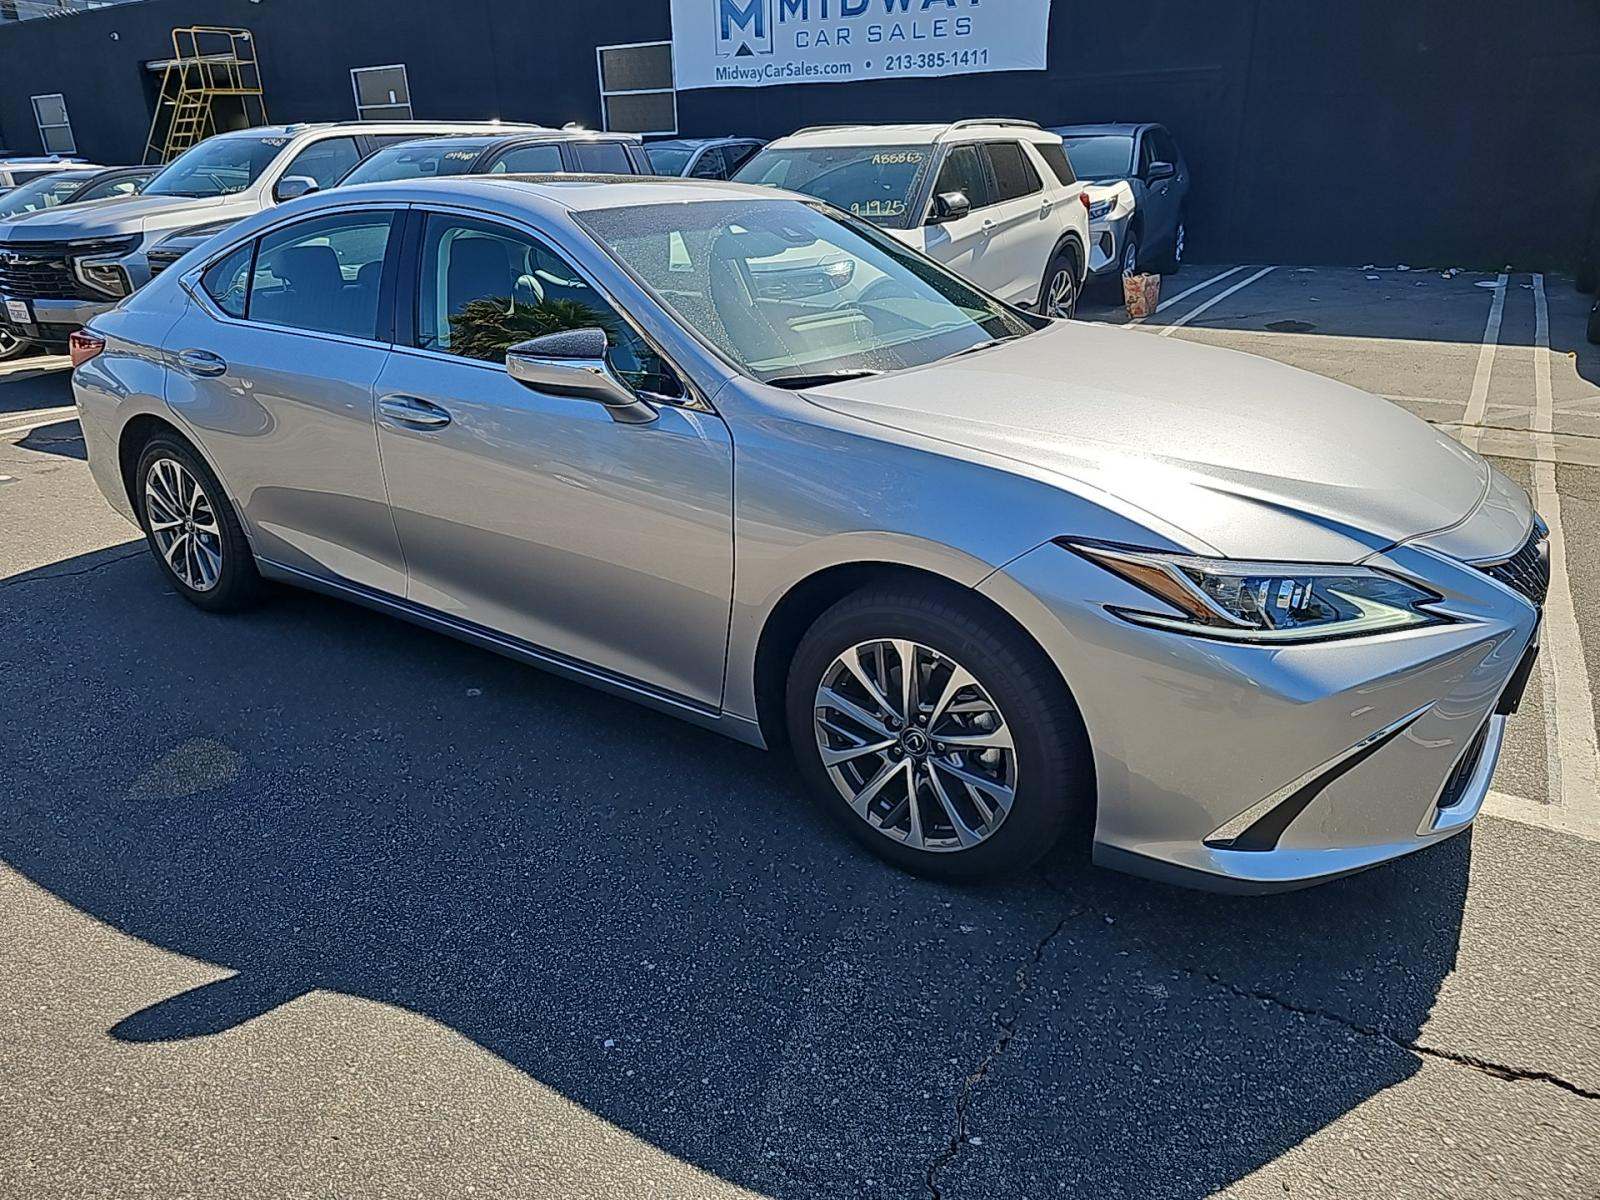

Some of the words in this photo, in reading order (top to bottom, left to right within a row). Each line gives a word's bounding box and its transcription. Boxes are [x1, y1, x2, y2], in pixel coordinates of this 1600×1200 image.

[720, 0, 765, 40] M
[796, 28, 851, 48] CAR
[867, 17, 972, 43] SALES
[715, 60, 852, 82] MidwayCarSales.com
[885, 49, 988, 71] 213-385-1411
